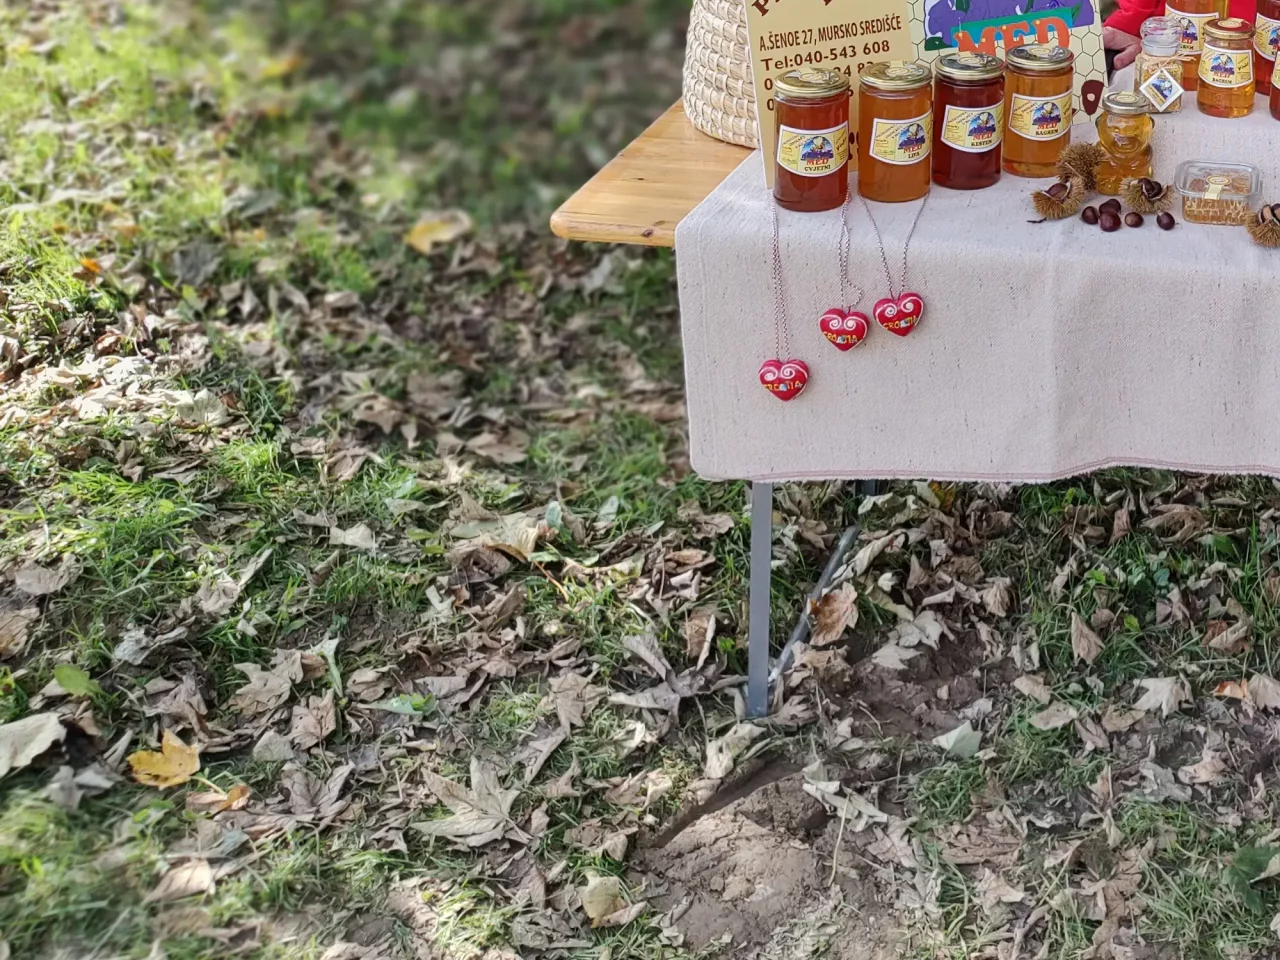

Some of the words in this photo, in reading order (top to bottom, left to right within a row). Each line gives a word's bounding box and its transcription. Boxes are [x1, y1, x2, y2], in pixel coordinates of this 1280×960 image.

[759, 31, 801, 52] A.ŠENOE
[801, 29, 817, 46] 27,
[818, 22, 858, 42] MURSKO
[860, 13, 902, 36] SREDIŠĆE
[760, 45, 857, 72] Tel:040-543
[863, 40, 890, 55] 608
